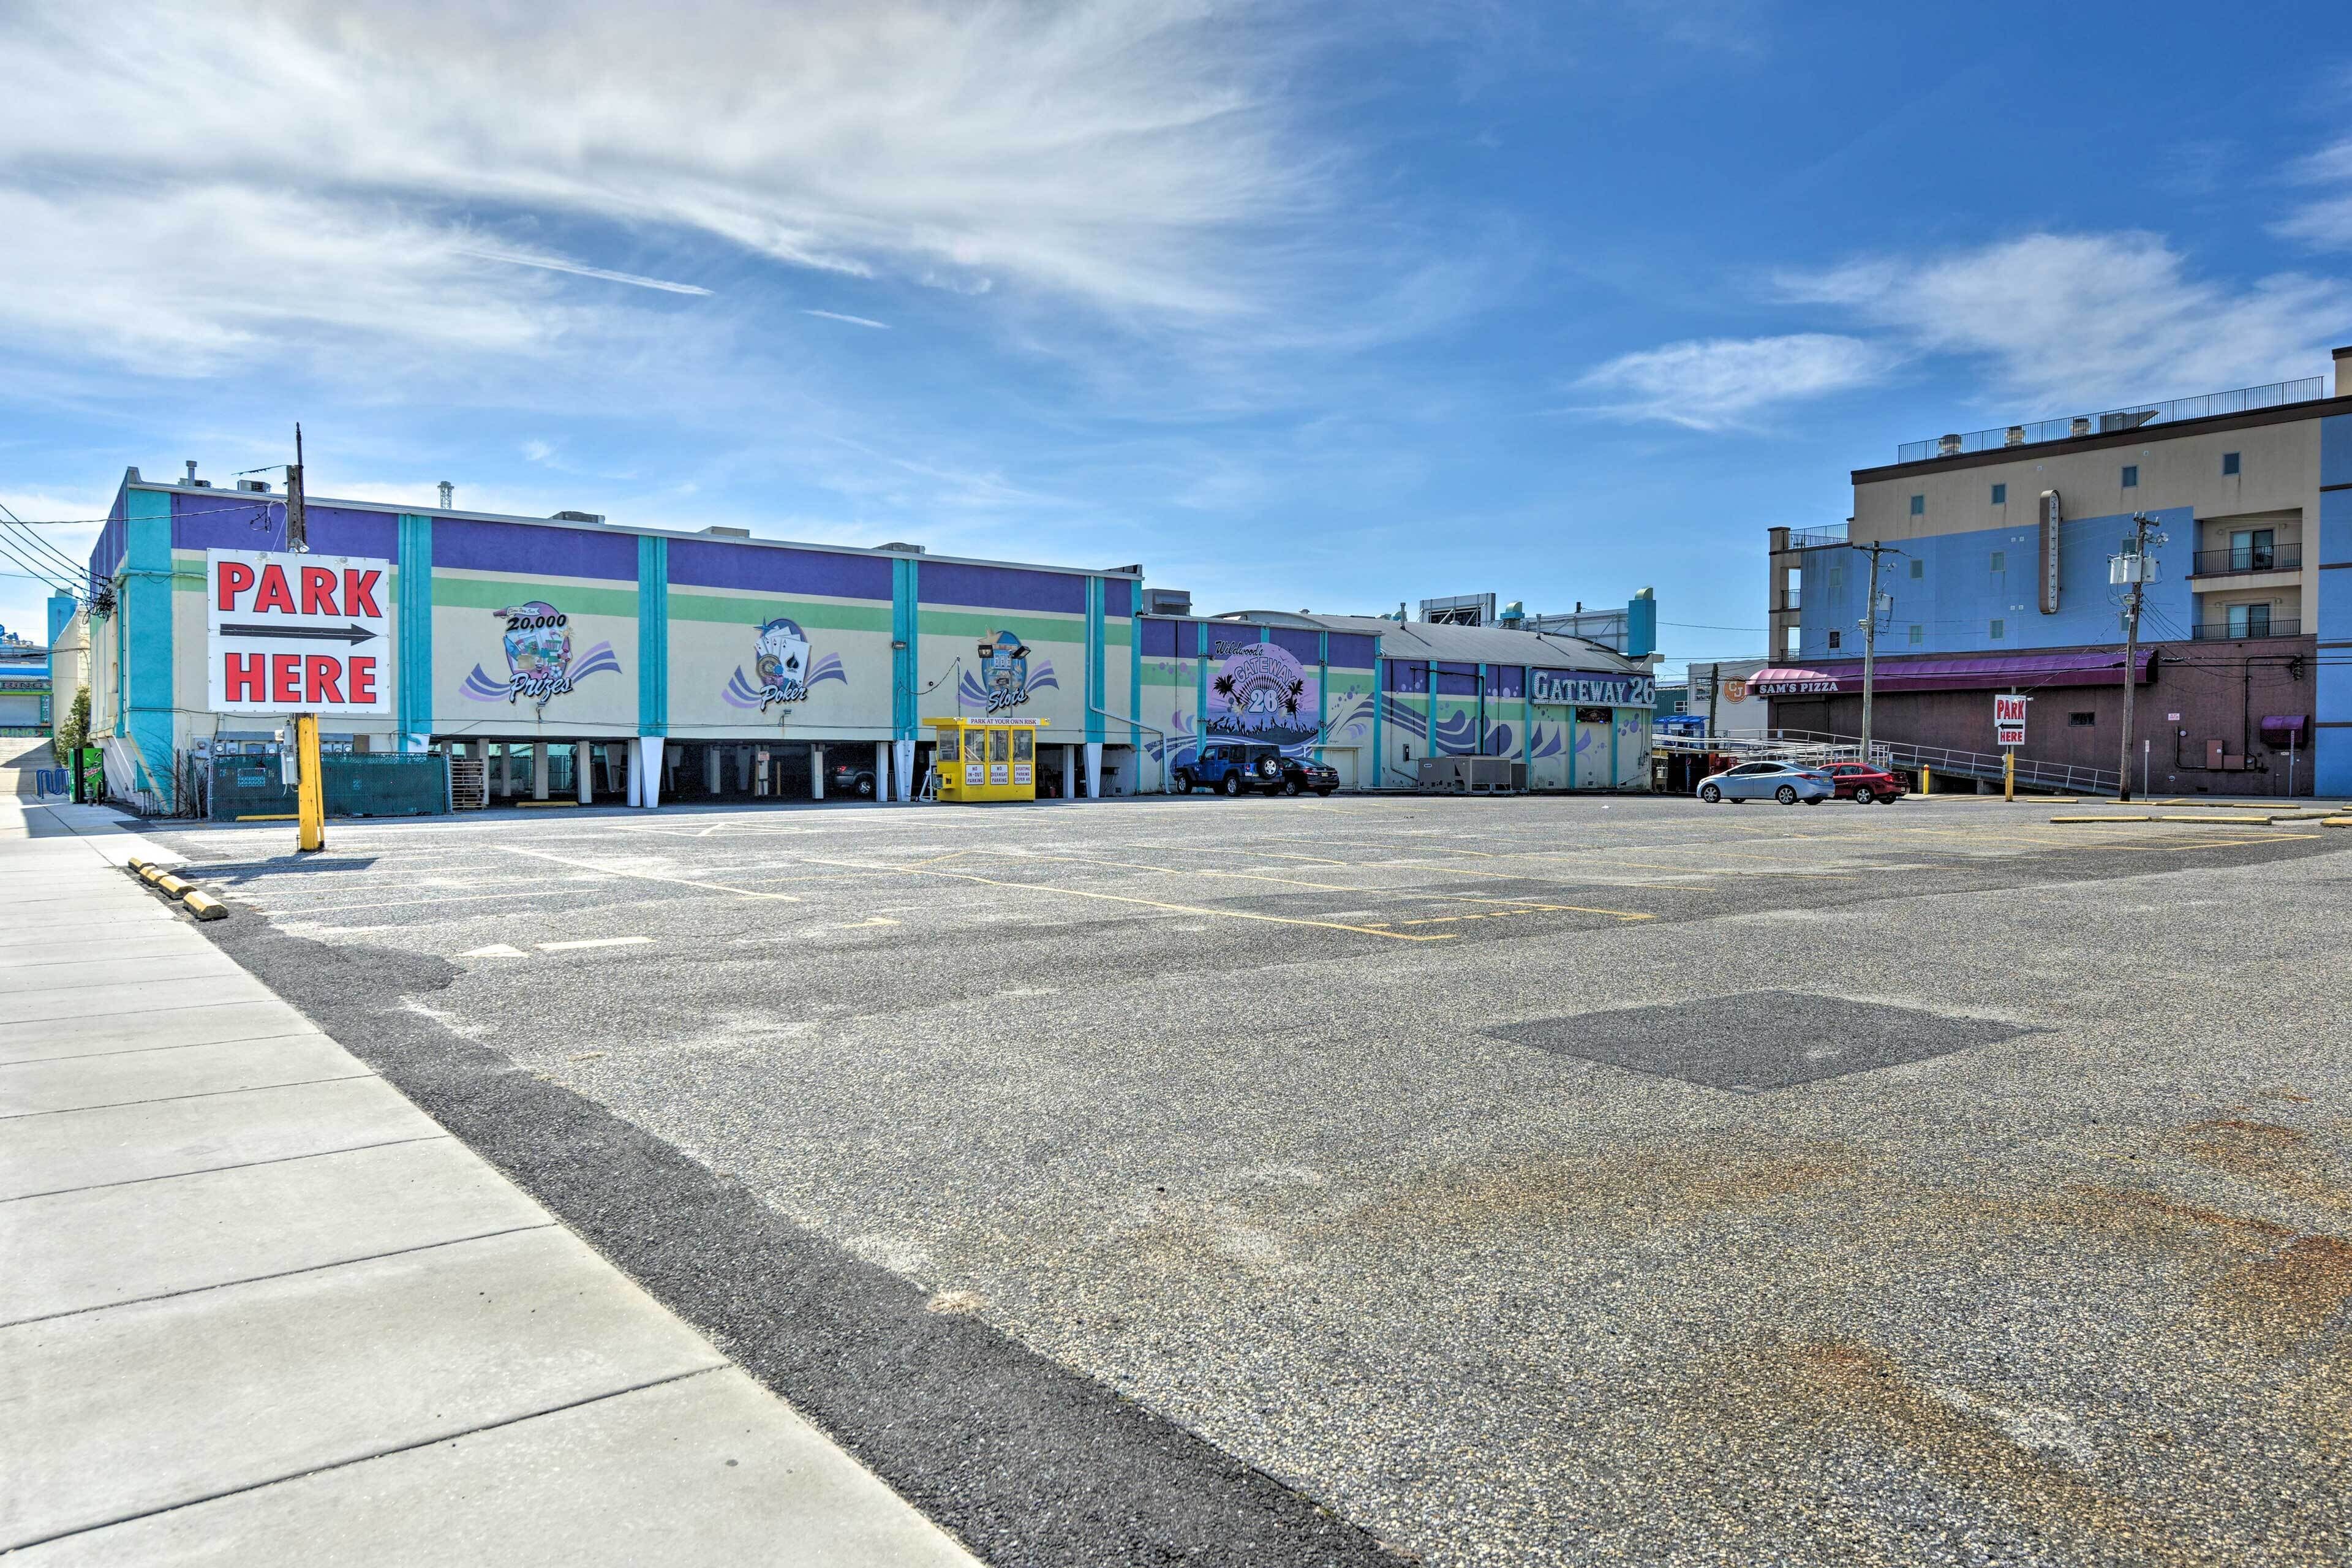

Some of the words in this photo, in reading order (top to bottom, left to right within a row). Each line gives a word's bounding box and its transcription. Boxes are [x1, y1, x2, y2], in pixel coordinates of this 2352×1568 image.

[217, 561, 383, 617] PARK
[506, 614, 567, 631] 20,000
[1215, 640, 1264, 656] Wildwood's
[225, 652, 377, 703] HERE
[1234, 657, 1297, 687] GATEWAY
[510, 671, 573, 703] Prizes
[760, 680, 808, 712] Poker
[988, 687, 1029, 714] Slots
[1248, 688, 1278, 713] 26
[1532, 671, 1627, 703] GATEWAY
[1759, 682, 1796, 693] SAM'S
[1801, 682, 1838, 693] PIZZA
[1997, 699, 2024, 719] PARK
[2000, 731, 2022, 742] HERE
